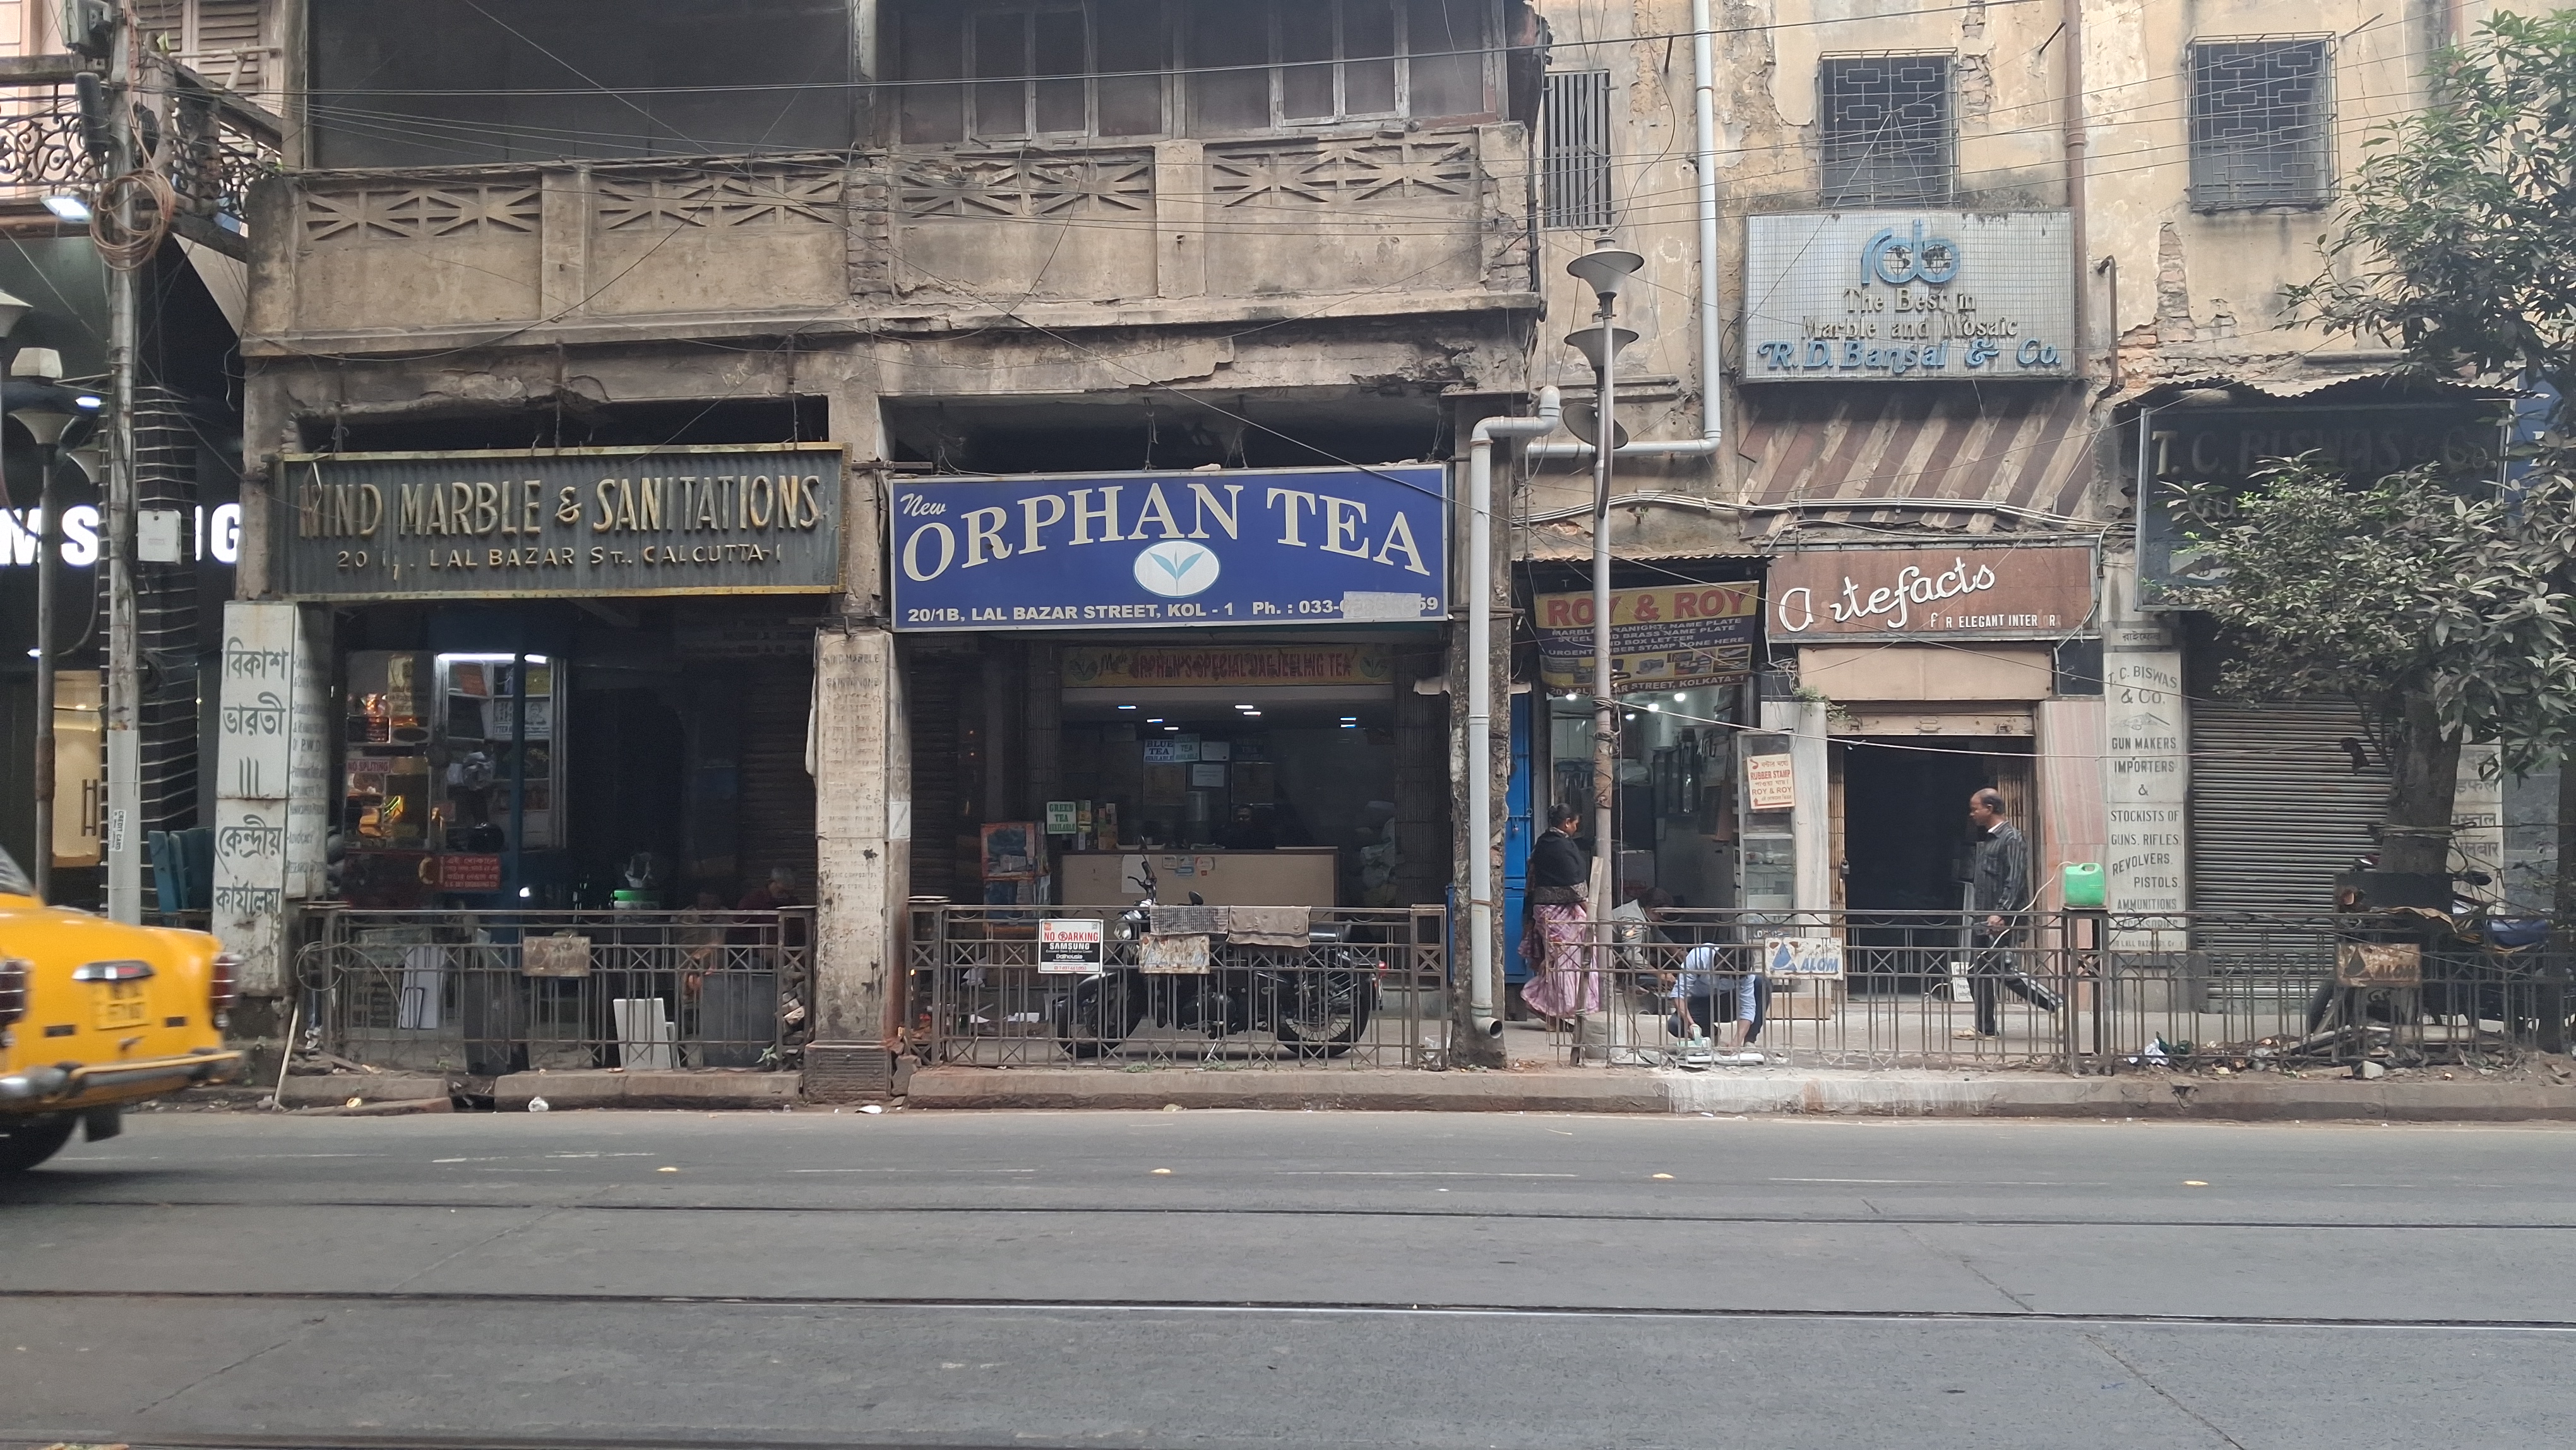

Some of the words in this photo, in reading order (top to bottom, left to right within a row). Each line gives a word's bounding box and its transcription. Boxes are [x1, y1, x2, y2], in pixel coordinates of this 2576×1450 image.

[1843, 287, 1884, 313] The
[1895, 287, 1946, 313] Best
[1801, 315, 1876, 340] Marble
[1891, 316, 1928, 339] and
[1943, 315, 2018, 338] Mosaic
[1966, 339, 2000, 366] &
[2017, 338, 2062, 366] Co.
[399, 479, 542, 536] MARBLE
[554, 486, 582, 525] &
[592, 474, 821, 534] SANITATIONS
[900, 493, 946, 517] New
[903, 482, 1244, 582] ORPHAN
[1266, 487, 1431, 576] TEA
[429, 549, 478, 567] LAL
[489, 547, 575, 566] BAZAR
[1634, 594, 1662, 622] &
[1674, 588, 1751, 619] ROY
[908, 608, 965, 622] 20/1B,
[972, 608, 1007, 621] LAL
[1013, 606, 1078, 620] BAZAR
[1083, 604, 1162, 619] STREET,
[1167, 604, 1207, 617] KOL
[1700, 624, 1736, 633] PLATE
[1706, 618, 1741, 626] PLATE
[1959, 614, 2005, 628] ELEGANT
[1638, 643, 1676, 651] STAMP
[224, 637, 289, 680] বিকাশ
[2133, 666, 2178, 688] BISWAS
[1631, 681, 1676, 690] STREET,
[2121, 688, 2133, 704] &
[223, 692, 287, 737] ভারতী
[2112, 737, 2132, 750] GUN
[2135, 737, 2176, 750] MAKERS
[2114, 760, 2175, 773] IMPORTERS
[1750, 770, 1772, 780] RUBBER
[1773, 769, 1791, 778] STAMP
[2138, 784, 2149, 796] &
[1054, 814, 1068, 822] TEA
[2110, 810, 2164, 822] STOCKISTS
[2168, 810, 2179, 822] OF
[2117, 899, 2177, 910] AMMUNITIONS
[1044, 932, 1055, 942] NO
[1049, 942, 1090, 950] SAMSUNG
